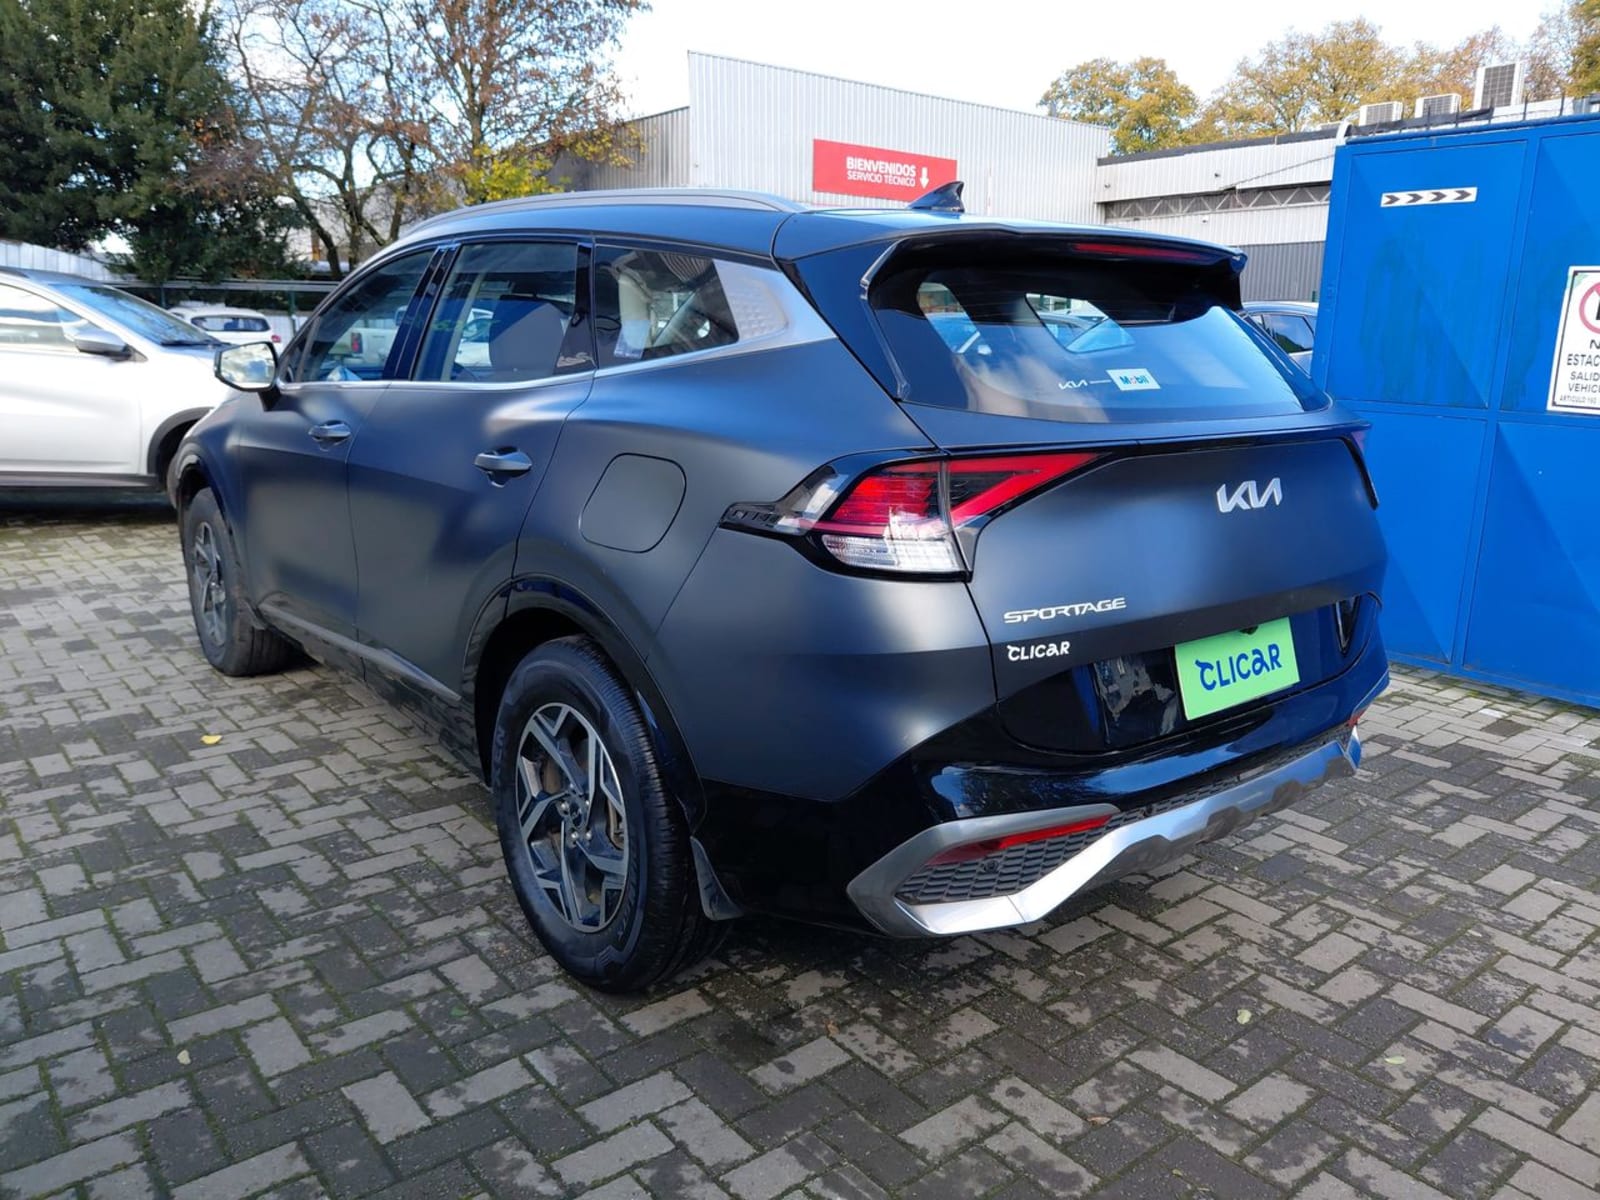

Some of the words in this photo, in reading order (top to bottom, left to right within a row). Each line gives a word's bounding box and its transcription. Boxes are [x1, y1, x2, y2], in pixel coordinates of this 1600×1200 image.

[846, 157, 916, 176] BIENVENIDOS
[847, 170, 882, 183] SERVICIO
[1568, 382, 1600, 393] VEHIC
[1216, 477, 1283, 513] KIA
[1003, 597, 1127, 624] SPORTAGE
